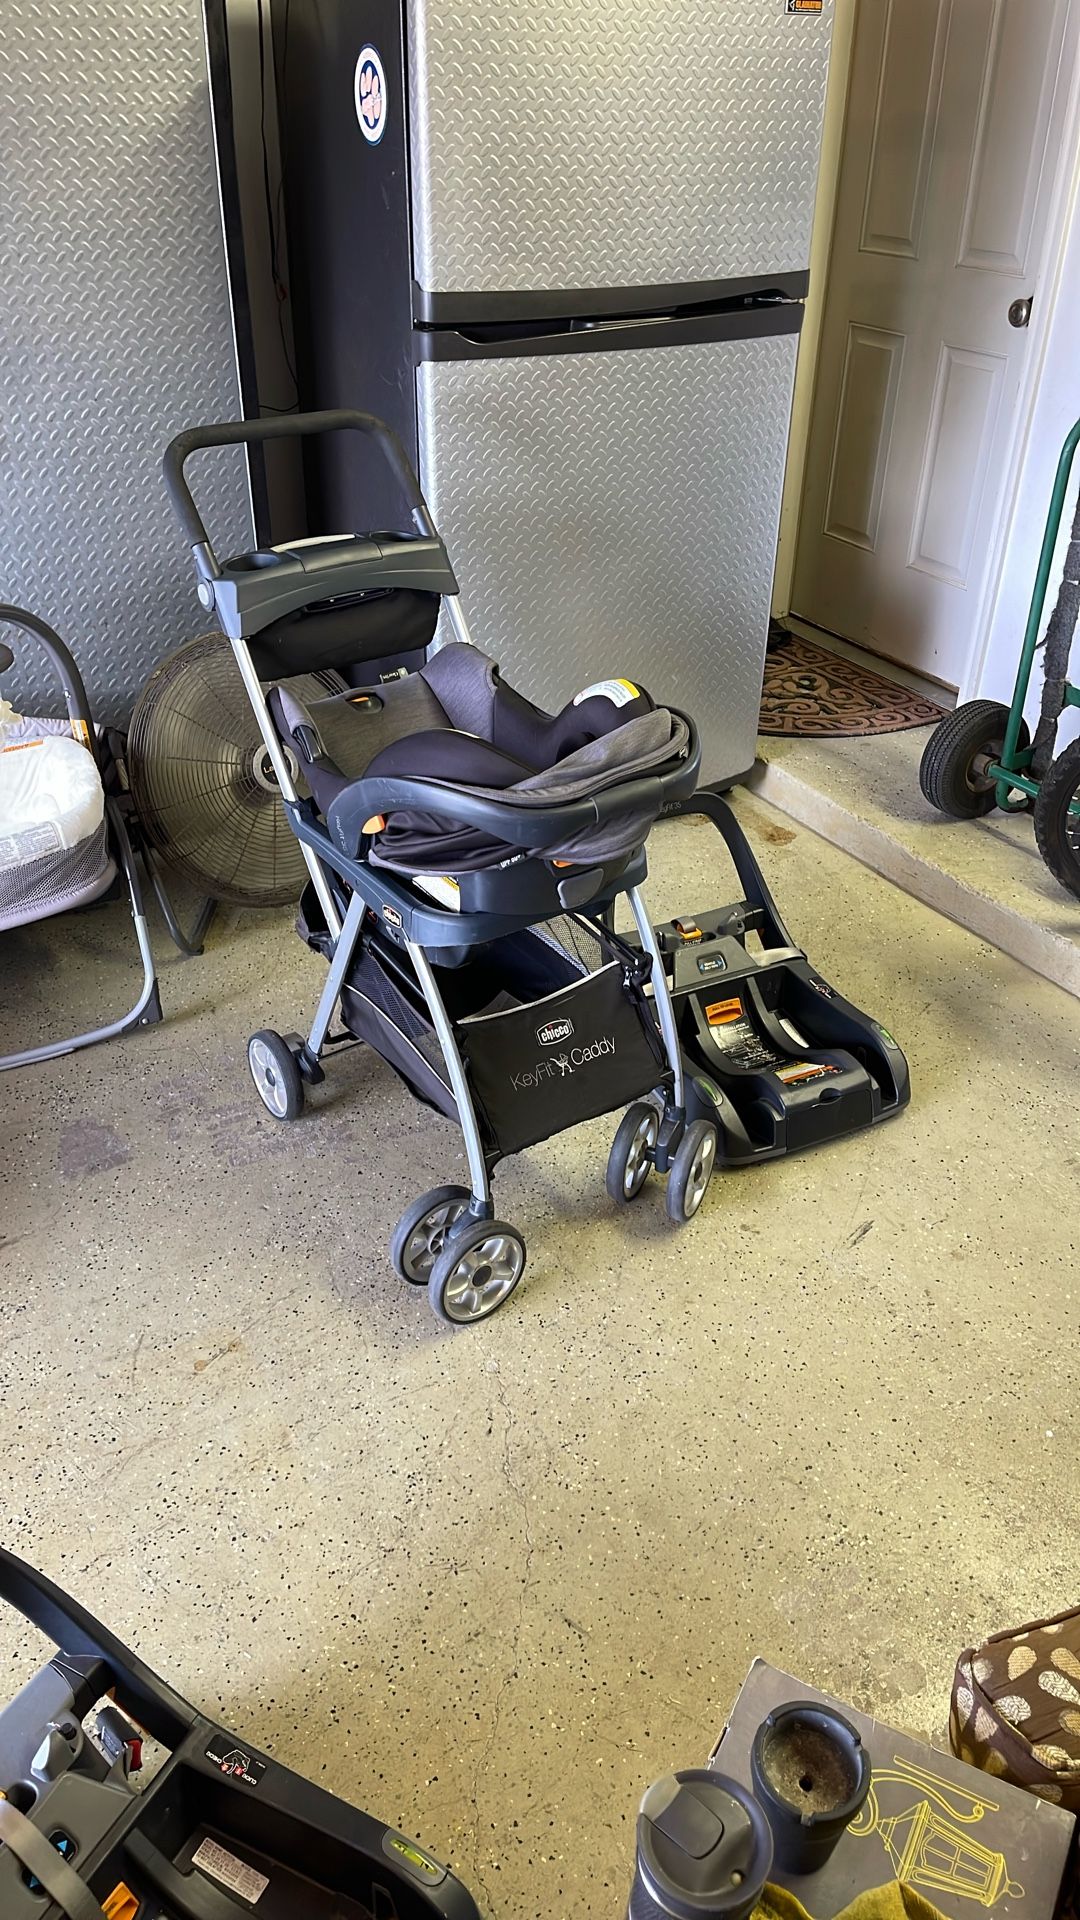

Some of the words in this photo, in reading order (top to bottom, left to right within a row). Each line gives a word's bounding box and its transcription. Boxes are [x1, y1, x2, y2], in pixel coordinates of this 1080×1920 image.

[541, 1024, 569, 1042] chicco
[509, 1061, 555, 1091] KeyFit
[570, 1036, 615, 1065] Caddy
